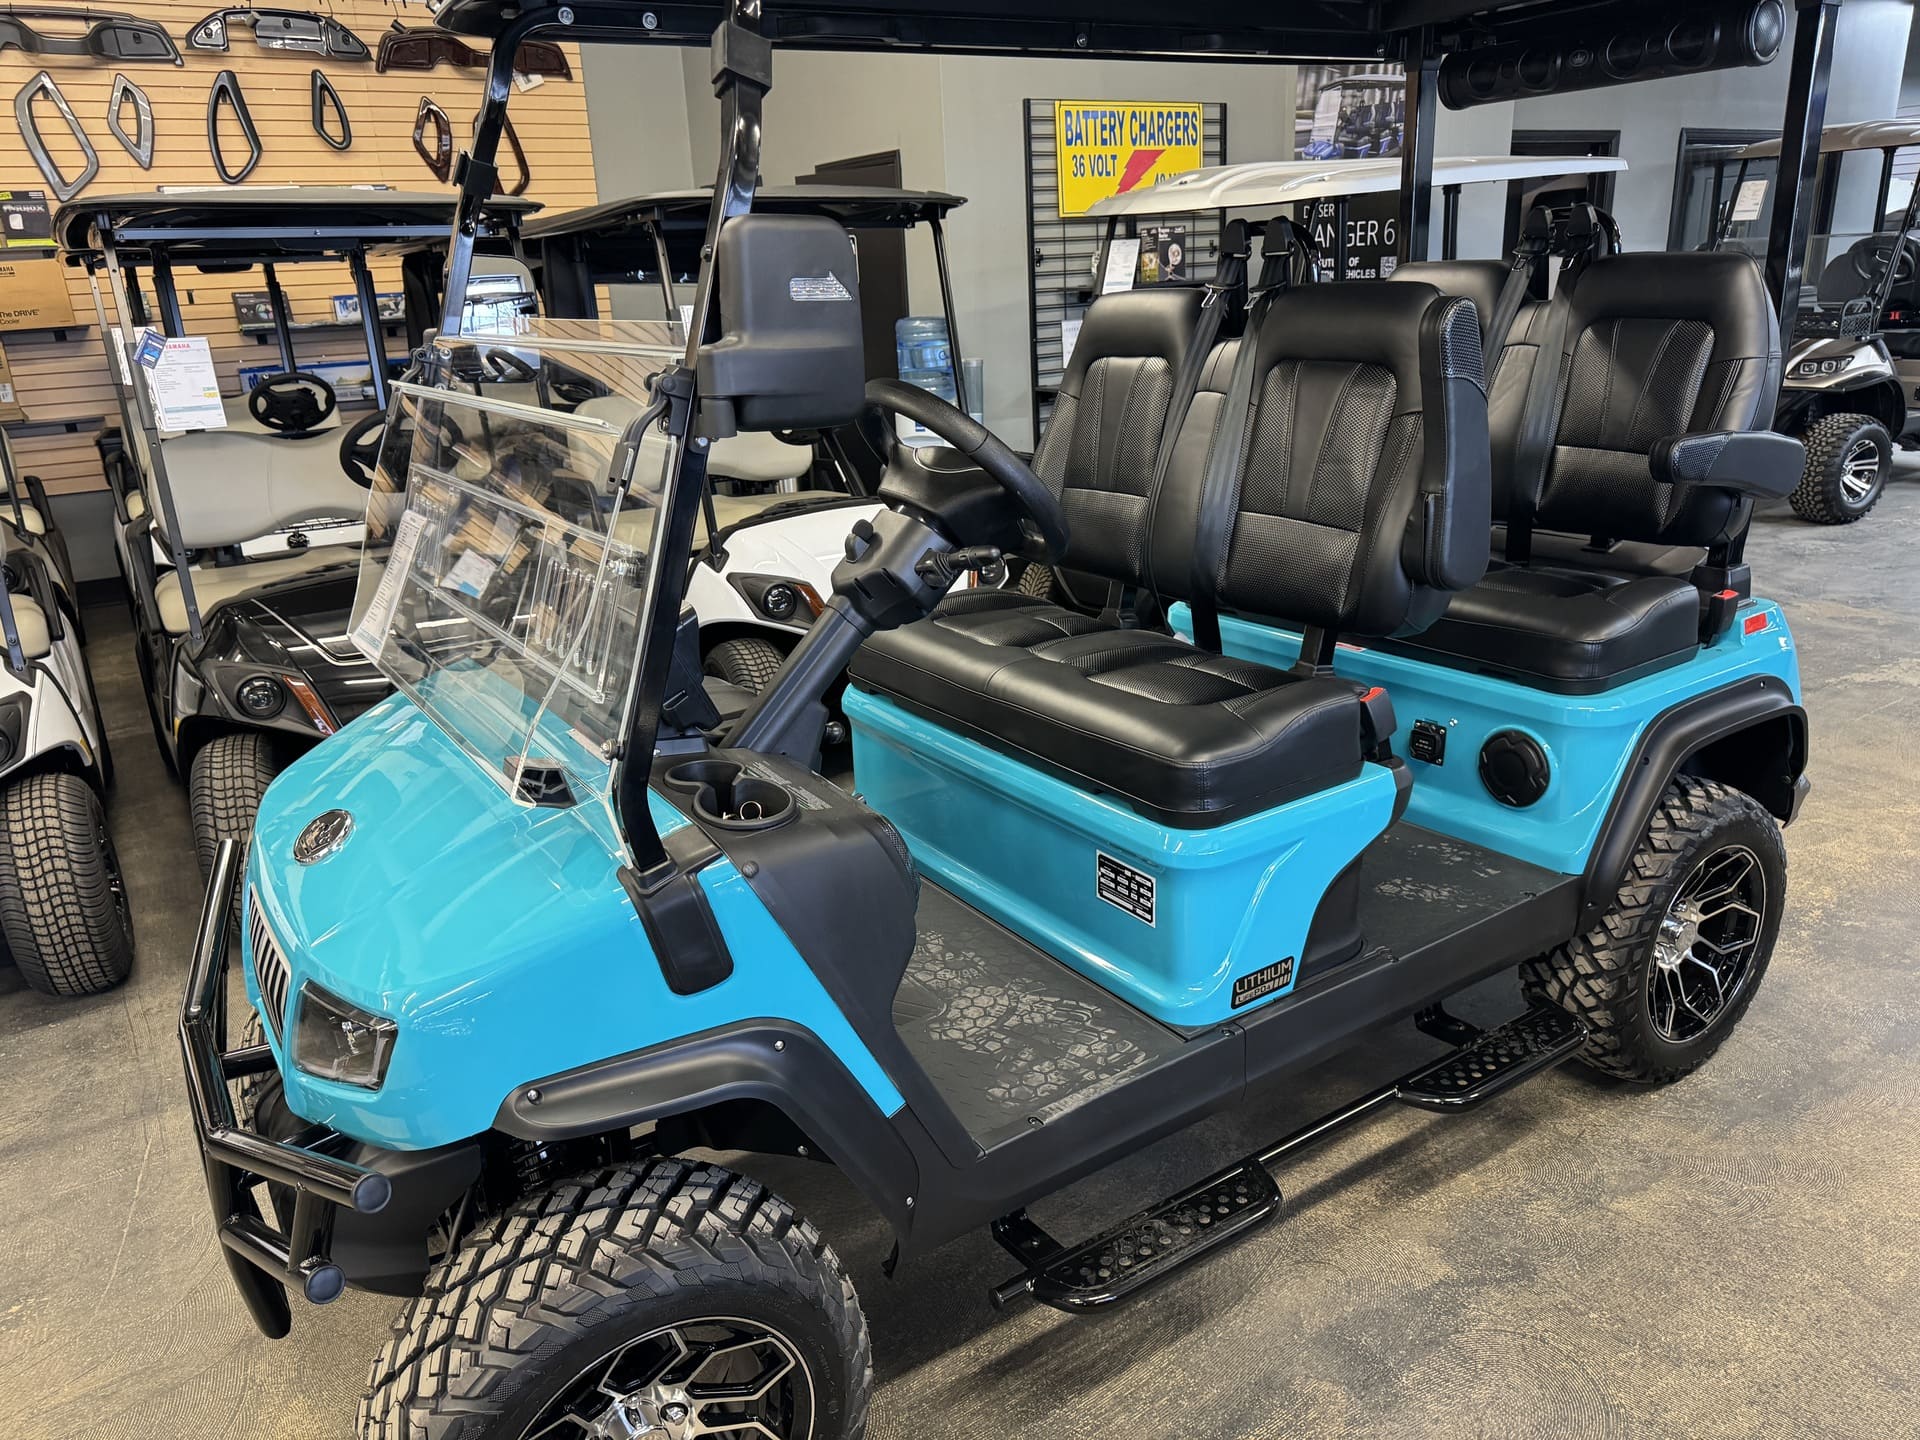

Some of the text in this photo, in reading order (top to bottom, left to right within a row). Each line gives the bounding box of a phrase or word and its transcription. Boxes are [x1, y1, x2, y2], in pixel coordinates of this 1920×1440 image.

[1065, 110, 1198, 146] BATTERY CHARGERS
[1072, 154, 1117, 177] 36 VOLT
[1303, 204, 1335, 219] DSER
[1303, 219, 1395, 249] ANGER 6
[1348, 257, 1360, 267] OF
[1236, 959, 1292, 993] LITHIUM
